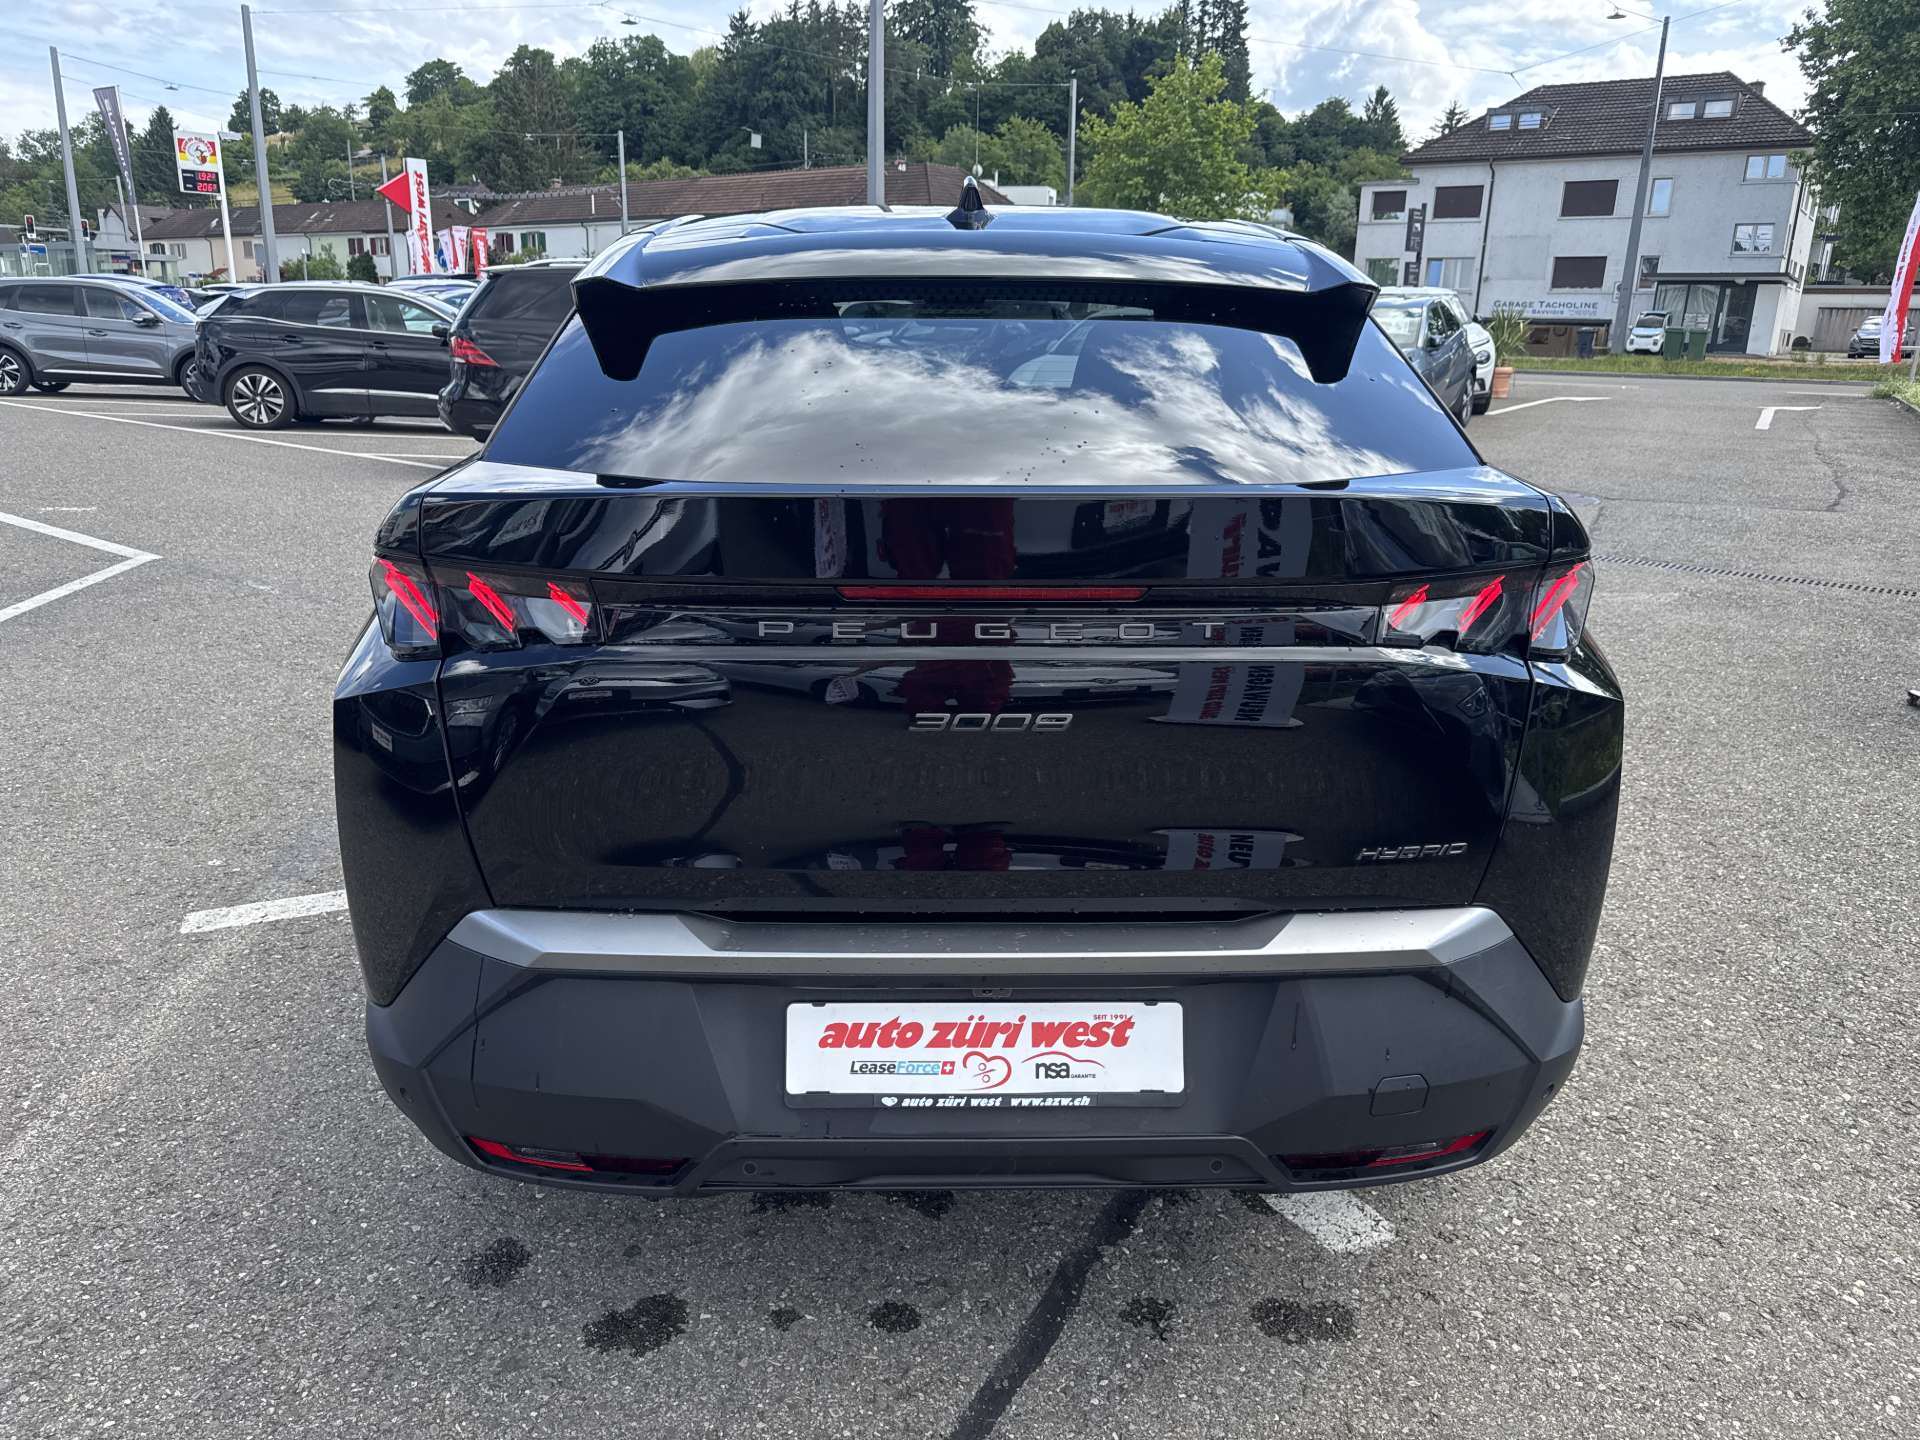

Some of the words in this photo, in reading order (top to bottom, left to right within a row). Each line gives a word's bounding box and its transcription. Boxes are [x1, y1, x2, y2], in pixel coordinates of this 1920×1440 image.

[414, 171, 425, 208] west
[758, 621, 1225, 640] PEUGEOT
[909, 713, 1073, 732] 3008
[1356, 842, 1468, 861] HYBRID
[818, 1015, 924, 1049] auto
[925, 1014, 1027, 1049] züri
[1031, 1015, 1136, 1049] west
[850, 1061, 940, 1075] LeaseForce
[1035, 1062, 1071, 1079] nsa
[901, 1096, 934, 1107] auto
[936, 1096, 967, 1107] züri
[970, 1096, 1003, 1107] west
[1010, 1096, 1091, 1107] www.azw.ch
